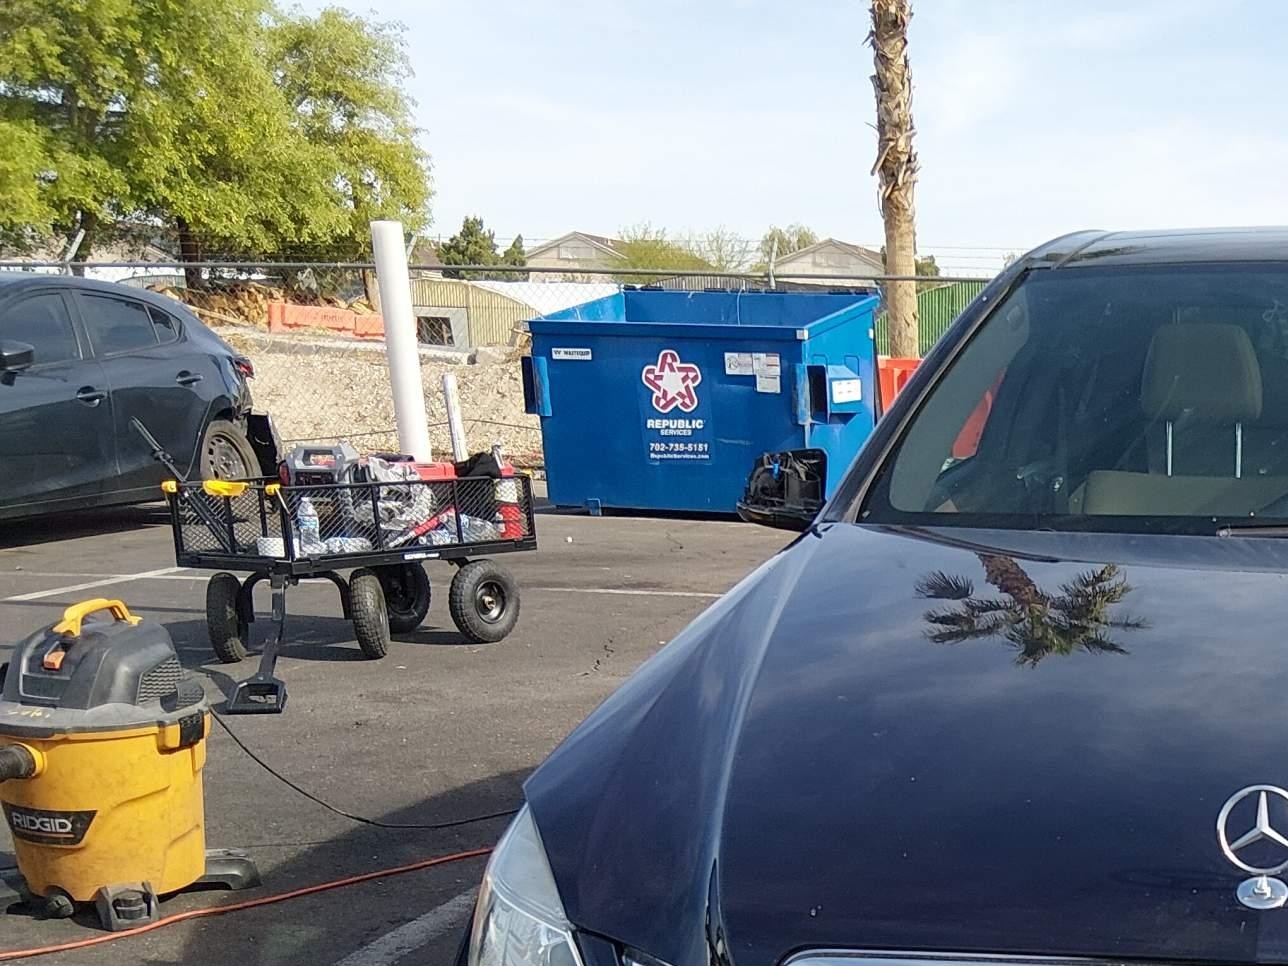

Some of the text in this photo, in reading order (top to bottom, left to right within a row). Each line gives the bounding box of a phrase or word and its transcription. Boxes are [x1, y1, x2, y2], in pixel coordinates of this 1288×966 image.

[646, 418, 704, 429] REPUBLIC
[649, 442, 709, 452] 702-735-5151
[12, 811, 73, 833] RIDGID
